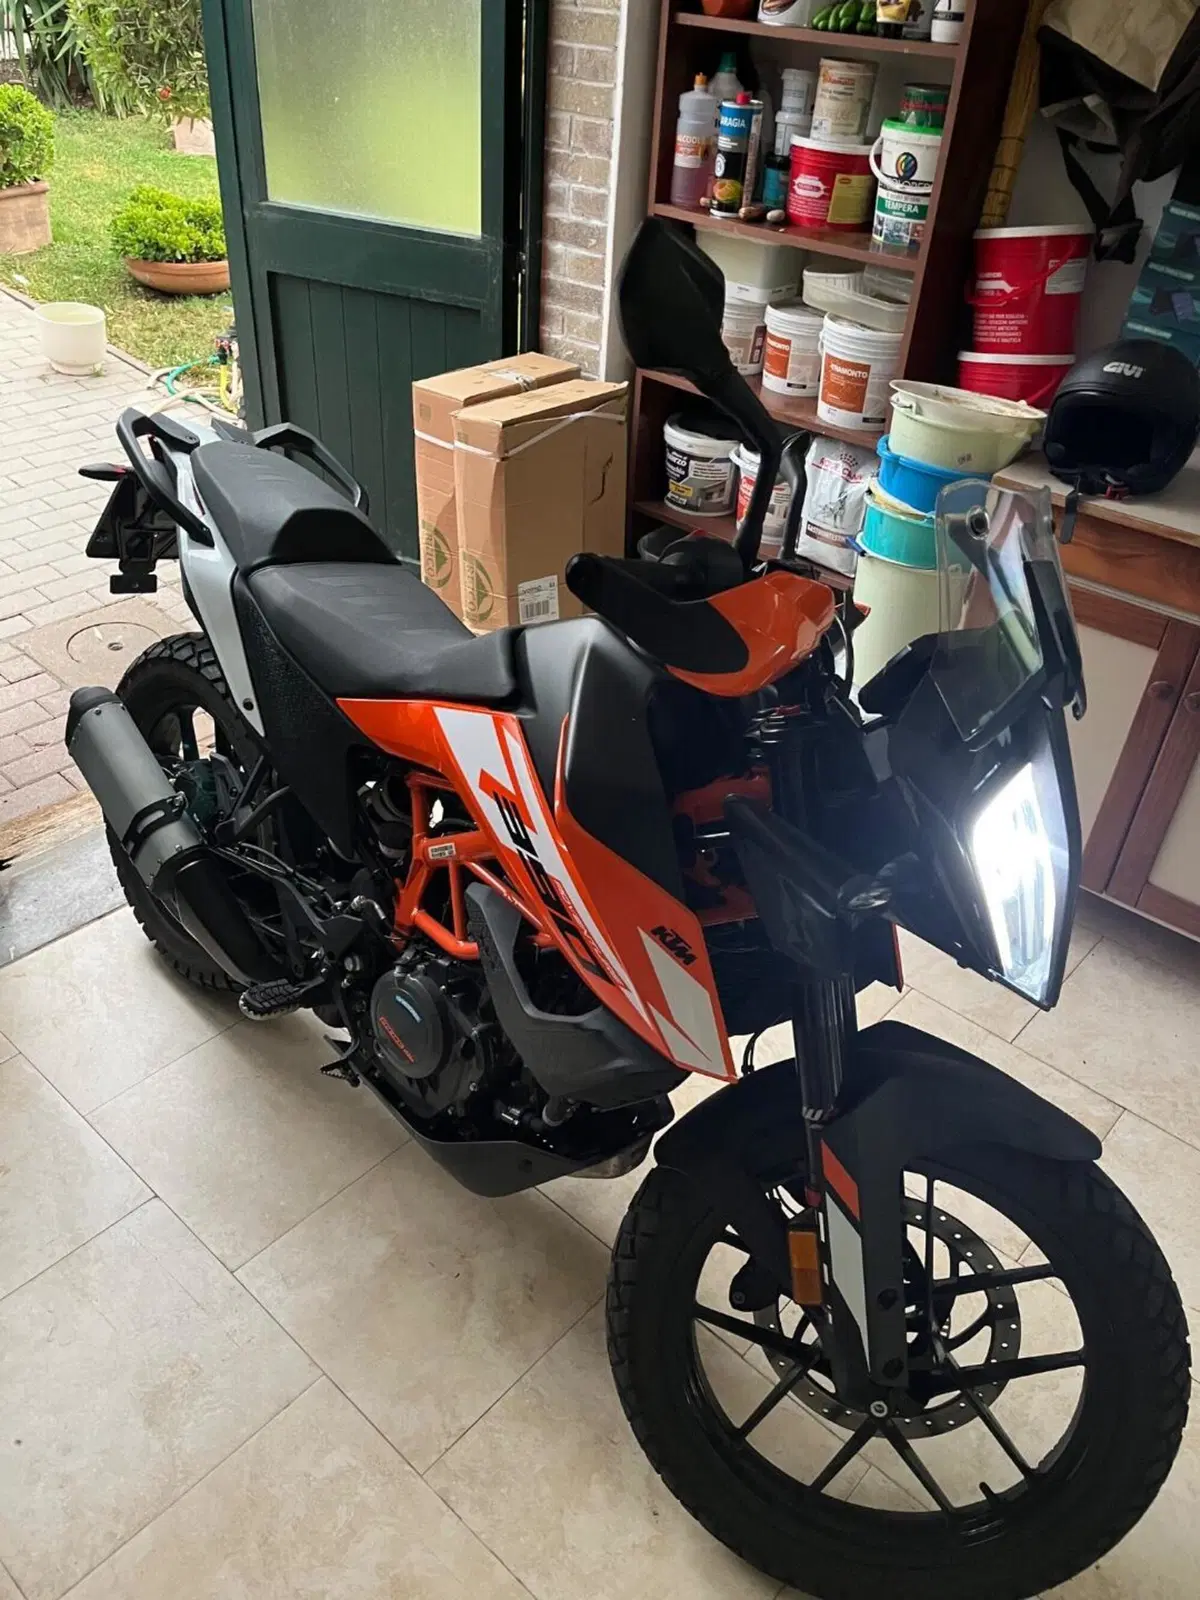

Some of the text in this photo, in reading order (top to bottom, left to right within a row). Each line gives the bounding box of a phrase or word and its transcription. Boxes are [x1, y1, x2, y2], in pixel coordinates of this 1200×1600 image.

[884, 200, 919, 214] TEMPERA
[830, 363, 868, 379] TRAMONTO
[1102, 361, 1143, 378] GIVI
[493, 790, 617, 986] 390
[650, 926, 697, 965] KTM
